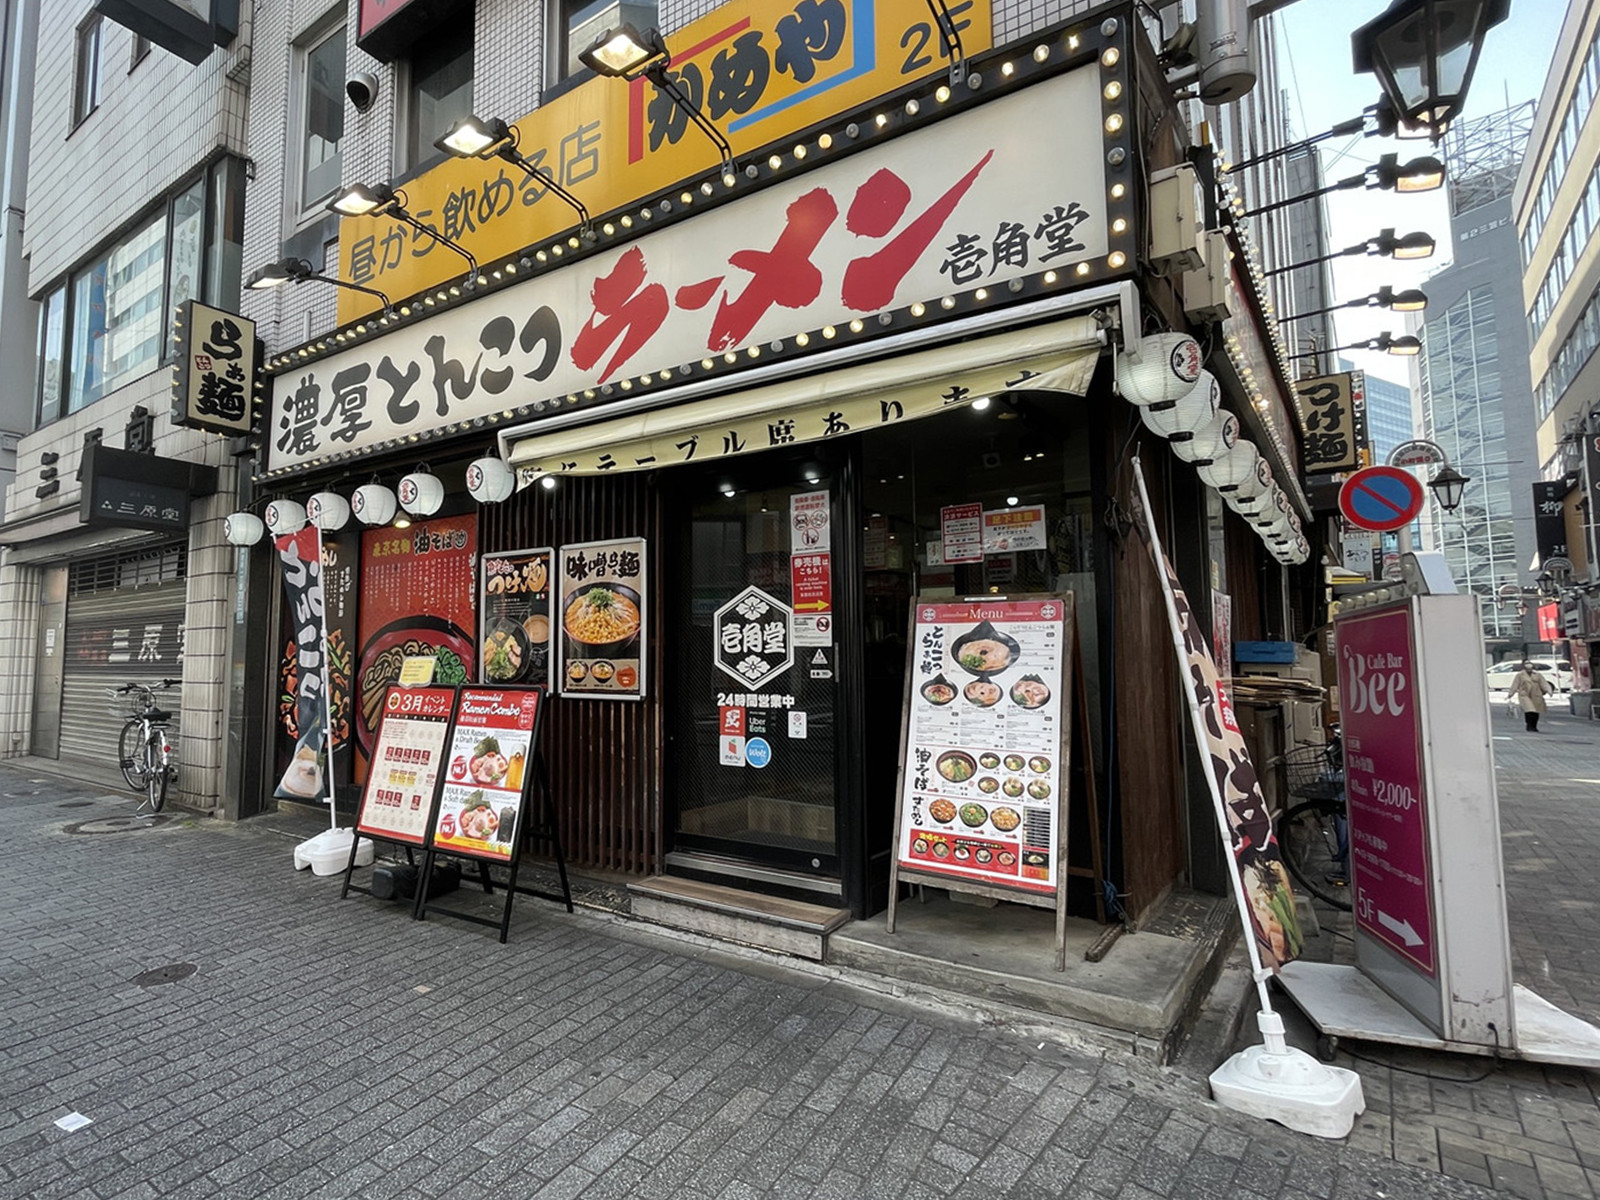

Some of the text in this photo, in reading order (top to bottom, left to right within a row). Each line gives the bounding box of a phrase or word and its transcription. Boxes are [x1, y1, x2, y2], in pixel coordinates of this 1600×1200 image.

[900, 0, 974, 75] 2F
[647, 0, 847, 152] かめや
[348, 121, 601, 287] 昼から飲める店
[938, 201, 1090, 286] 壱角堂
[277, 148, 995, 457] 濃厚とんこつ ラーメン
[1297, 382, 1349, 465] つけ麺
[116, 502, 180, 521] 三原堂
[969, 608, 1004, 620] Menu
[720, 620, 787, 654] 壱角堂
[1367, 652, 1404, 670] Cafe Bar
[1343, 644, 1406, 717] Bee
[401, 694, 424, 712] 3月
[717, 692, 796, 709] 24時間営業中
[749, 717, 766, 726] Uber
[749, 725, 767, 733] Eats
[1357, 886, 1375, 923] 5F
